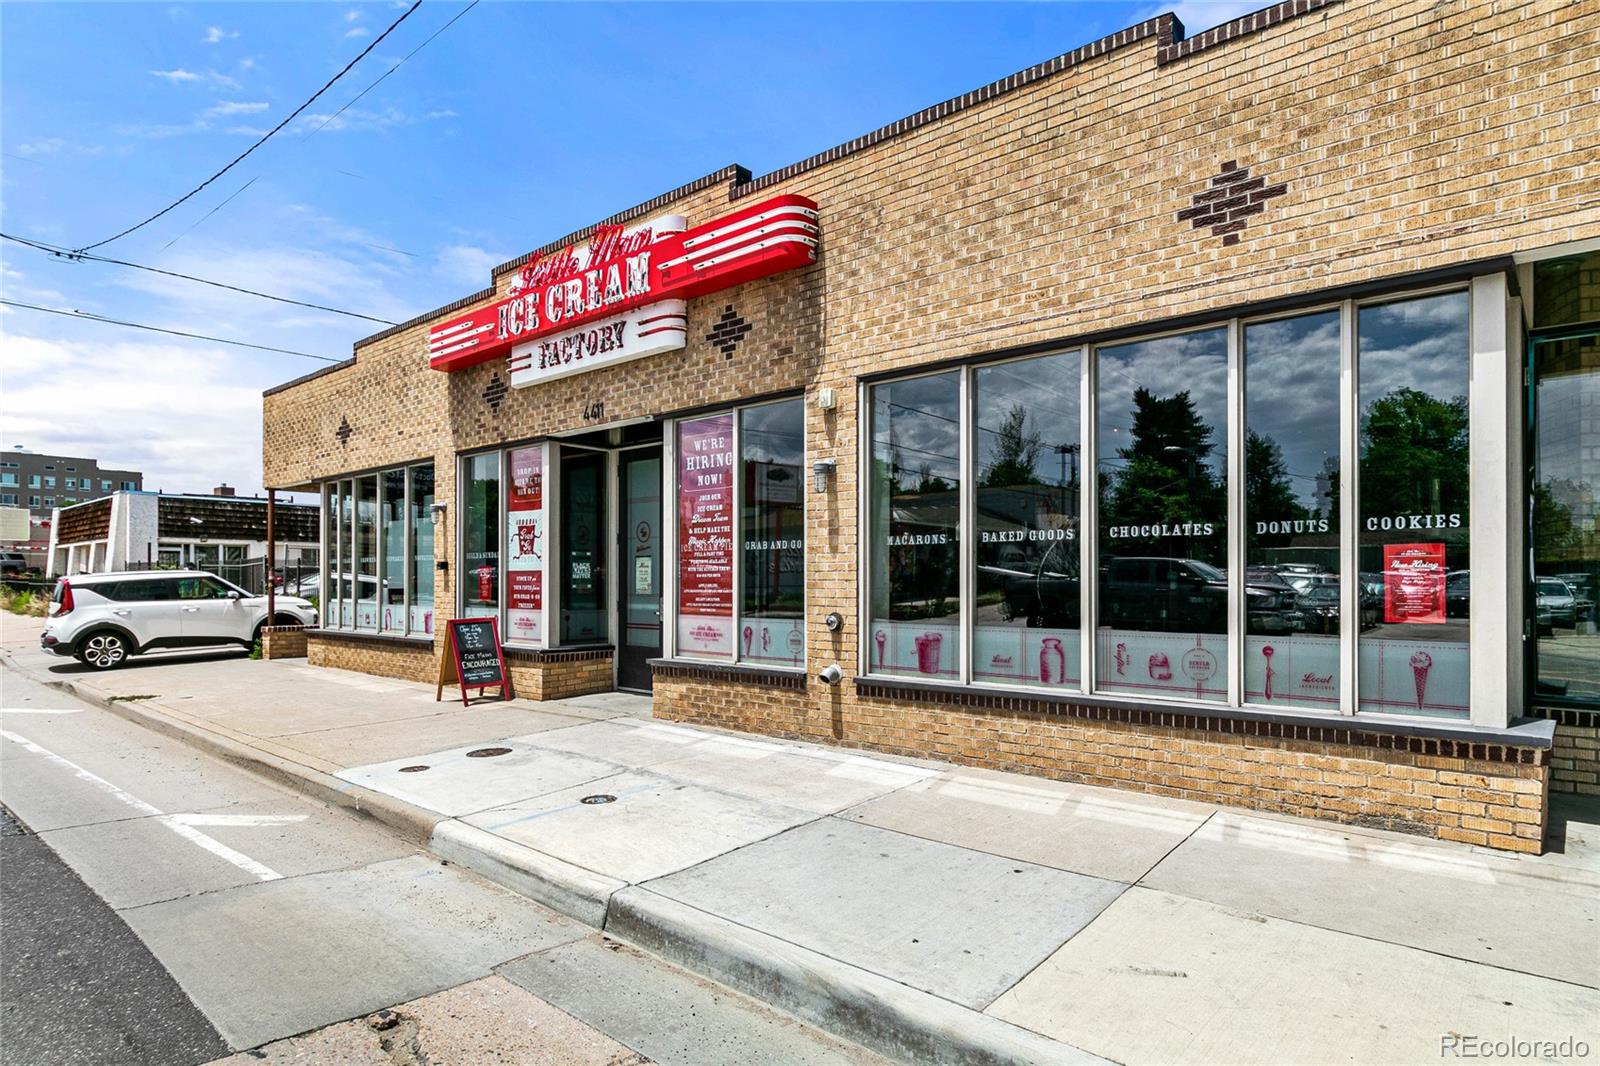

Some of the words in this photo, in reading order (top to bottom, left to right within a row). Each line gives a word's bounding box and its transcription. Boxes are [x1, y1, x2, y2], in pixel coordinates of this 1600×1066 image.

[585, 223, 653, 269] Man
[497, 292, 539, 340] ICE
[545, 251, 651, 323] CREAM
[538, 320, 627, 369] FACTORY
[583, 402, 605, 420] 4411
[694, 437, 725, 451] WE'RE
[686, 452, 732, 470] HIRING
[697, 473, 722, 486] NOW!
[1256, 519, 1329, 535] DONUTS
[1366, 513, 1461, 531] COOKIES
[982, 530, 1024, 542] BAKED
[1029, 529, 1074, 541] GOODS
[1109, 523, 1214, 538] CHOCOLATES
[745, 541, 768, 550] GRAB
[770, 540, 788, 550] AND
[790, 539, 802, 549] GO
[886, 534, 946, 546] MACARONS
[1391, 559, 1409, 568] Now
[1409, 559, 1439, 570] Hiring
[1113, 642, 1126, 676] Crafted
[1301, 672, 1333, 684] Local
